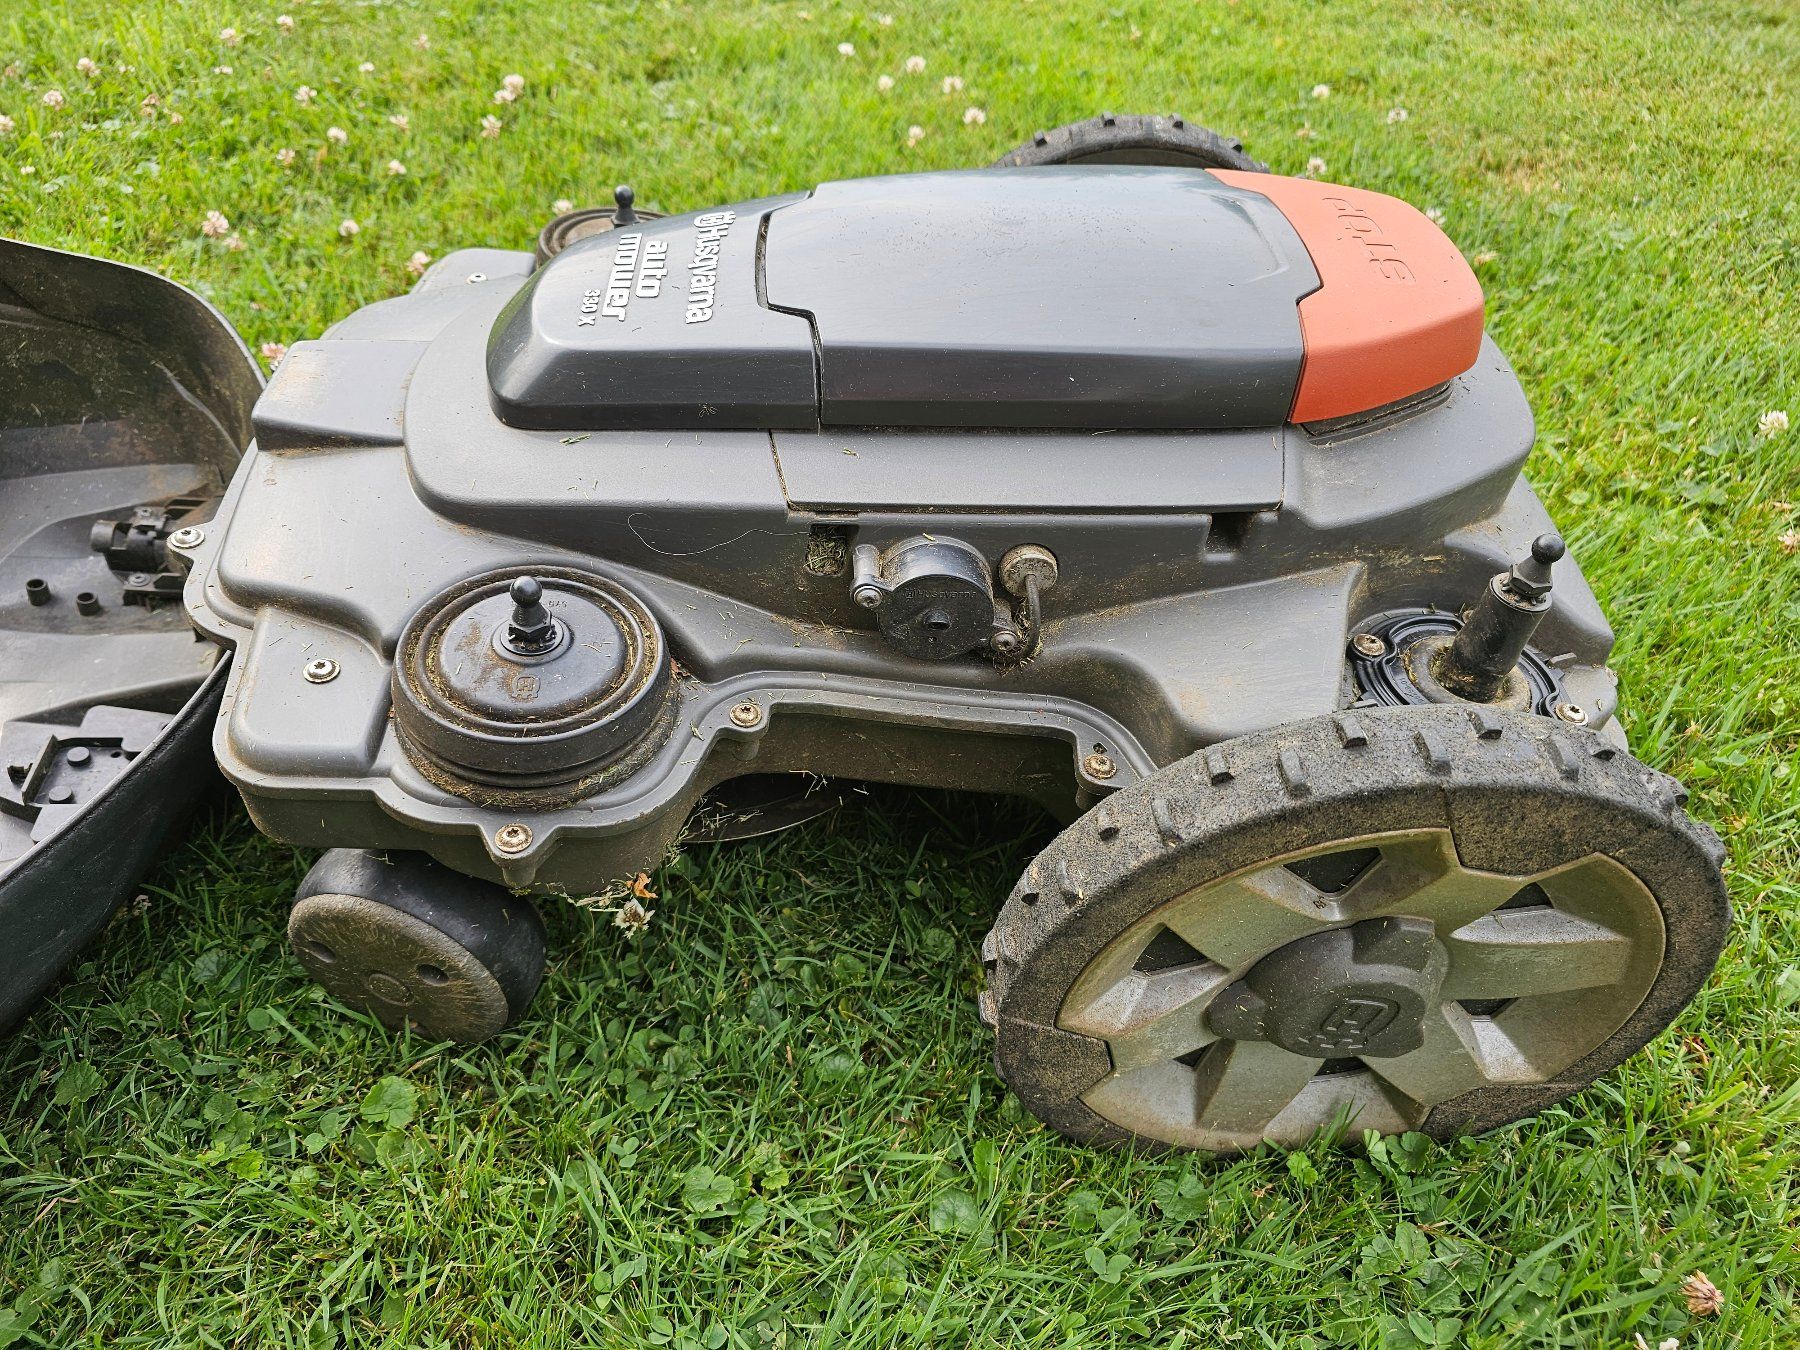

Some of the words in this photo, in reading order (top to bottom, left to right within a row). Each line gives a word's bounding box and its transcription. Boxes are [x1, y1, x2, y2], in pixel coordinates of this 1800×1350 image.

[602, 233, 643, 322] mower
[635, 240, 668, 298] auto
[685, 224, 729, 324] Husqvarna
[577, 315, 597, 327] X
[581, 289, 601, 313] 330
